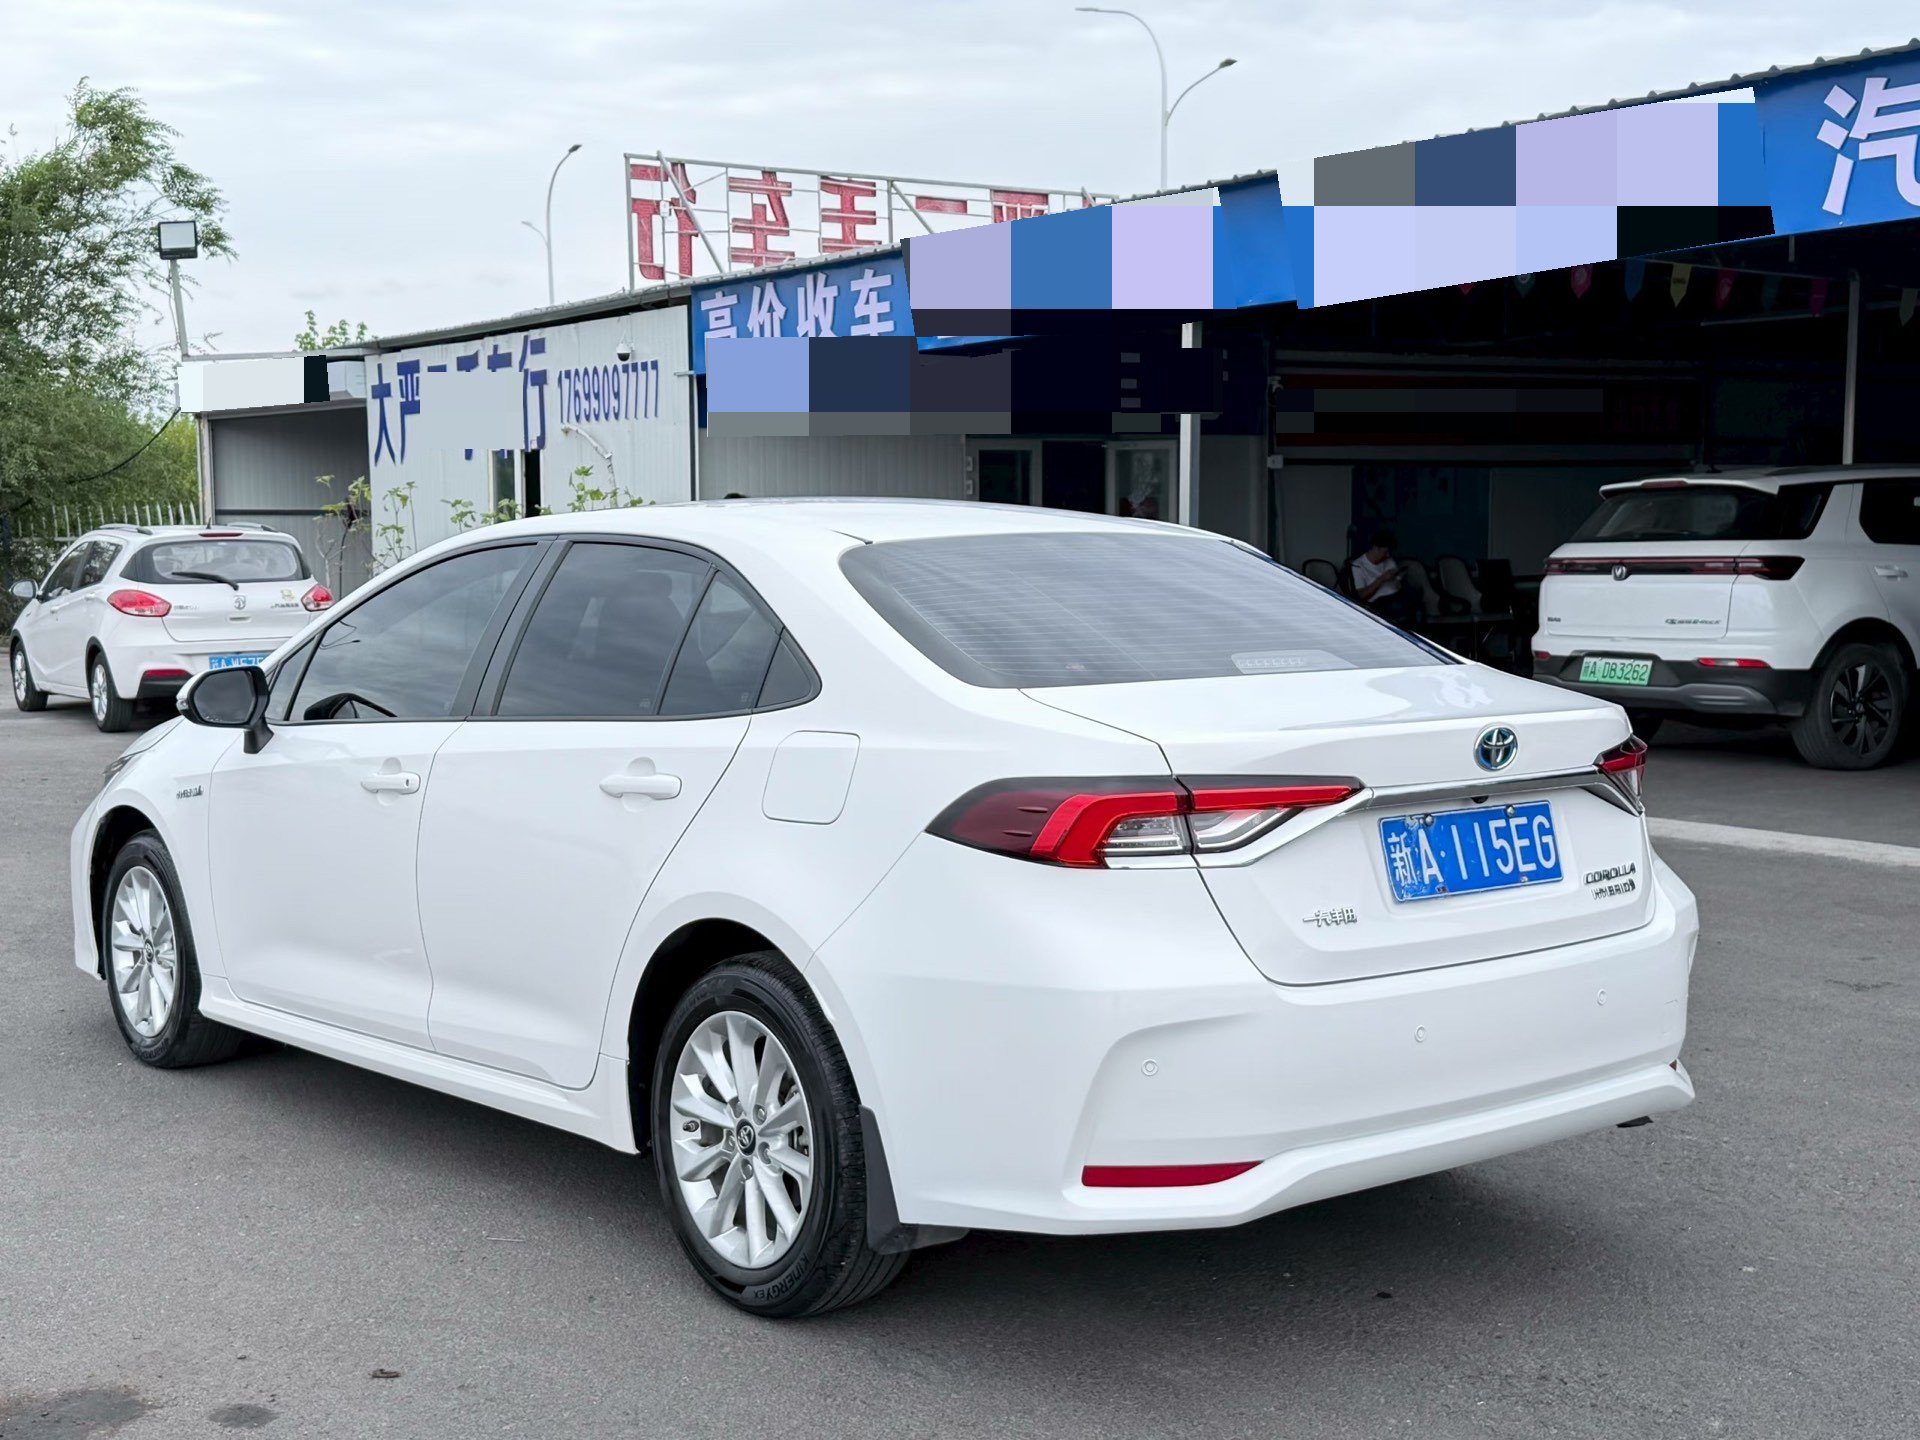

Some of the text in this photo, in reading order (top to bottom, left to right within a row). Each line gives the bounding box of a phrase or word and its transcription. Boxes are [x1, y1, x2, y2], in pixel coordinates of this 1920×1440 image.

[1815, 77, 1920, 217] 汽
[700, 268, 895, 338] 高价收车
[557, 359, 659, 424] 17699097777
[1584, 862, 1637, 886] COROLLA
[1302, 906, 1358, 927] 一汽丰田
